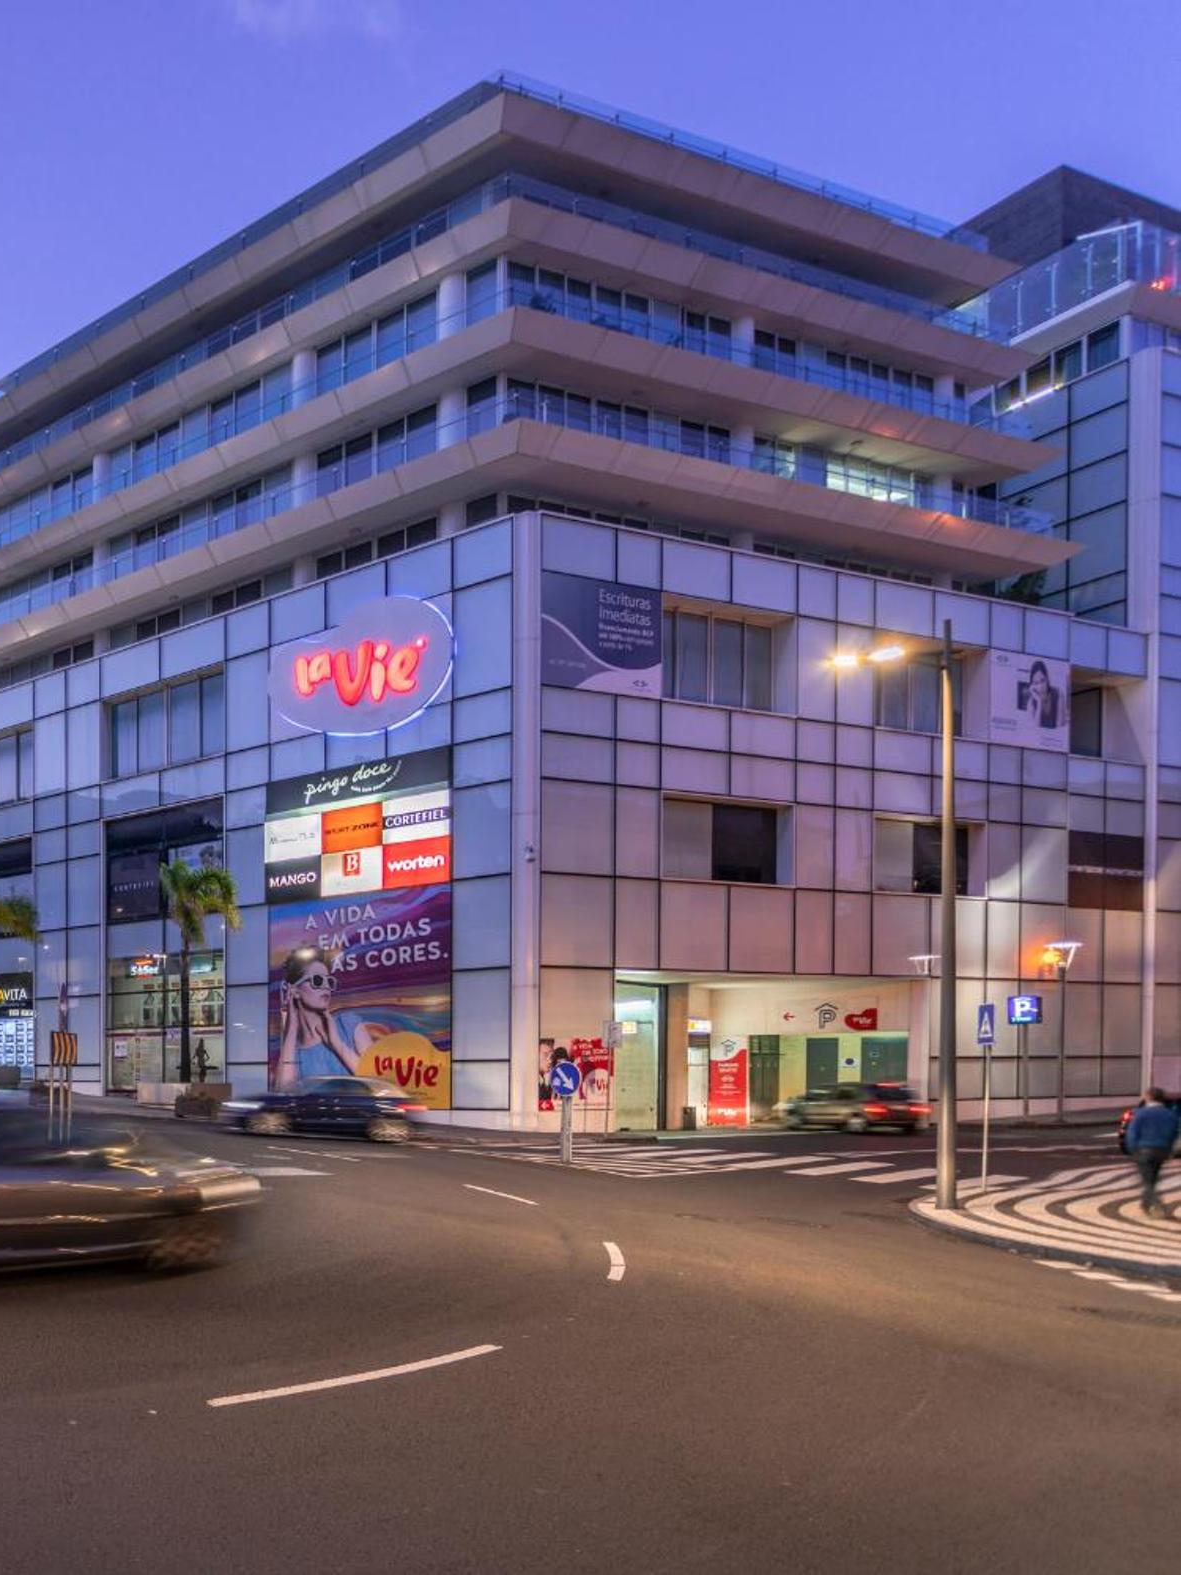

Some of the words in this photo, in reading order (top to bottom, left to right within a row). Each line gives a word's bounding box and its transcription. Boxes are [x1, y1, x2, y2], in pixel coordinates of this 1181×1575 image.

[599, 588, 652, 610] Escrituras
[303, 776, 349, 805] pingo
[352, 762, 392, 784] doce
[385, 808, 447, 828] CORTEFIEL
[387, 854, 445, 873] worten
[269, 871, 317, 889] MANGO
[305, 914, 318, 930] A
[324, 904, 377, 926] VIDA
[319, 934, 350, 951] EM
[357, 918, 432, 945] TODAS
[331, 954, 358, 974] AS
[365, 942, 449, 968] CORES.
